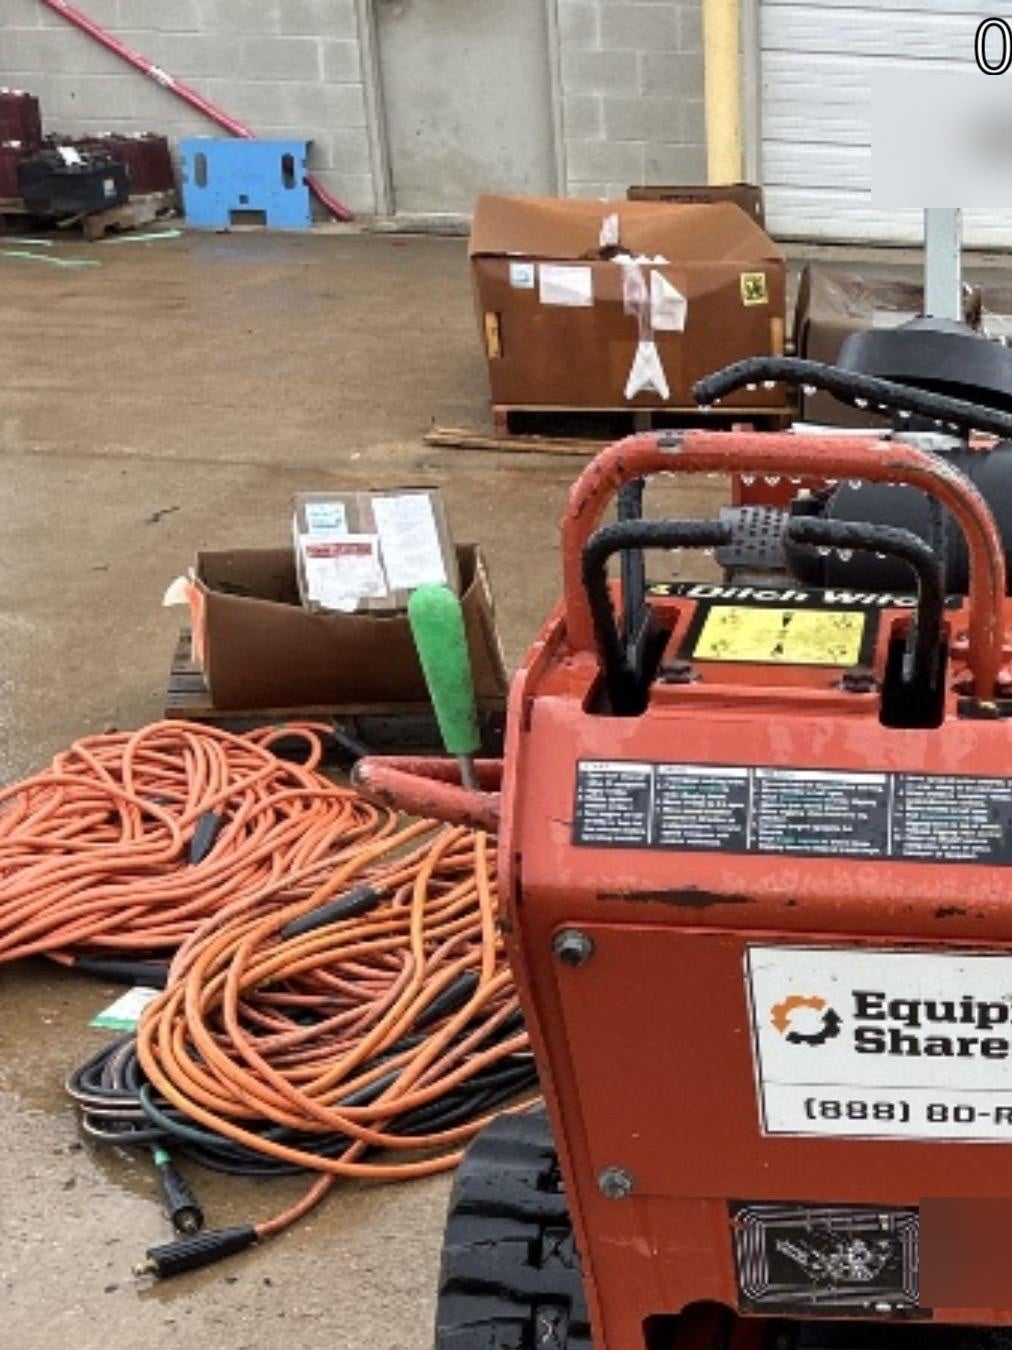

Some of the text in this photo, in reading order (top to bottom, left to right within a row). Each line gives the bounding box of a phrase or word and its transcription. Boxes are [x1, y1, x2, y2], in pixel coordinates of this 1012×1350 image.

[823, 590, 919, 607] Witc
[852, 1026, 1010, 1060] Share
[804, 1097, 910, 1123] (888)
